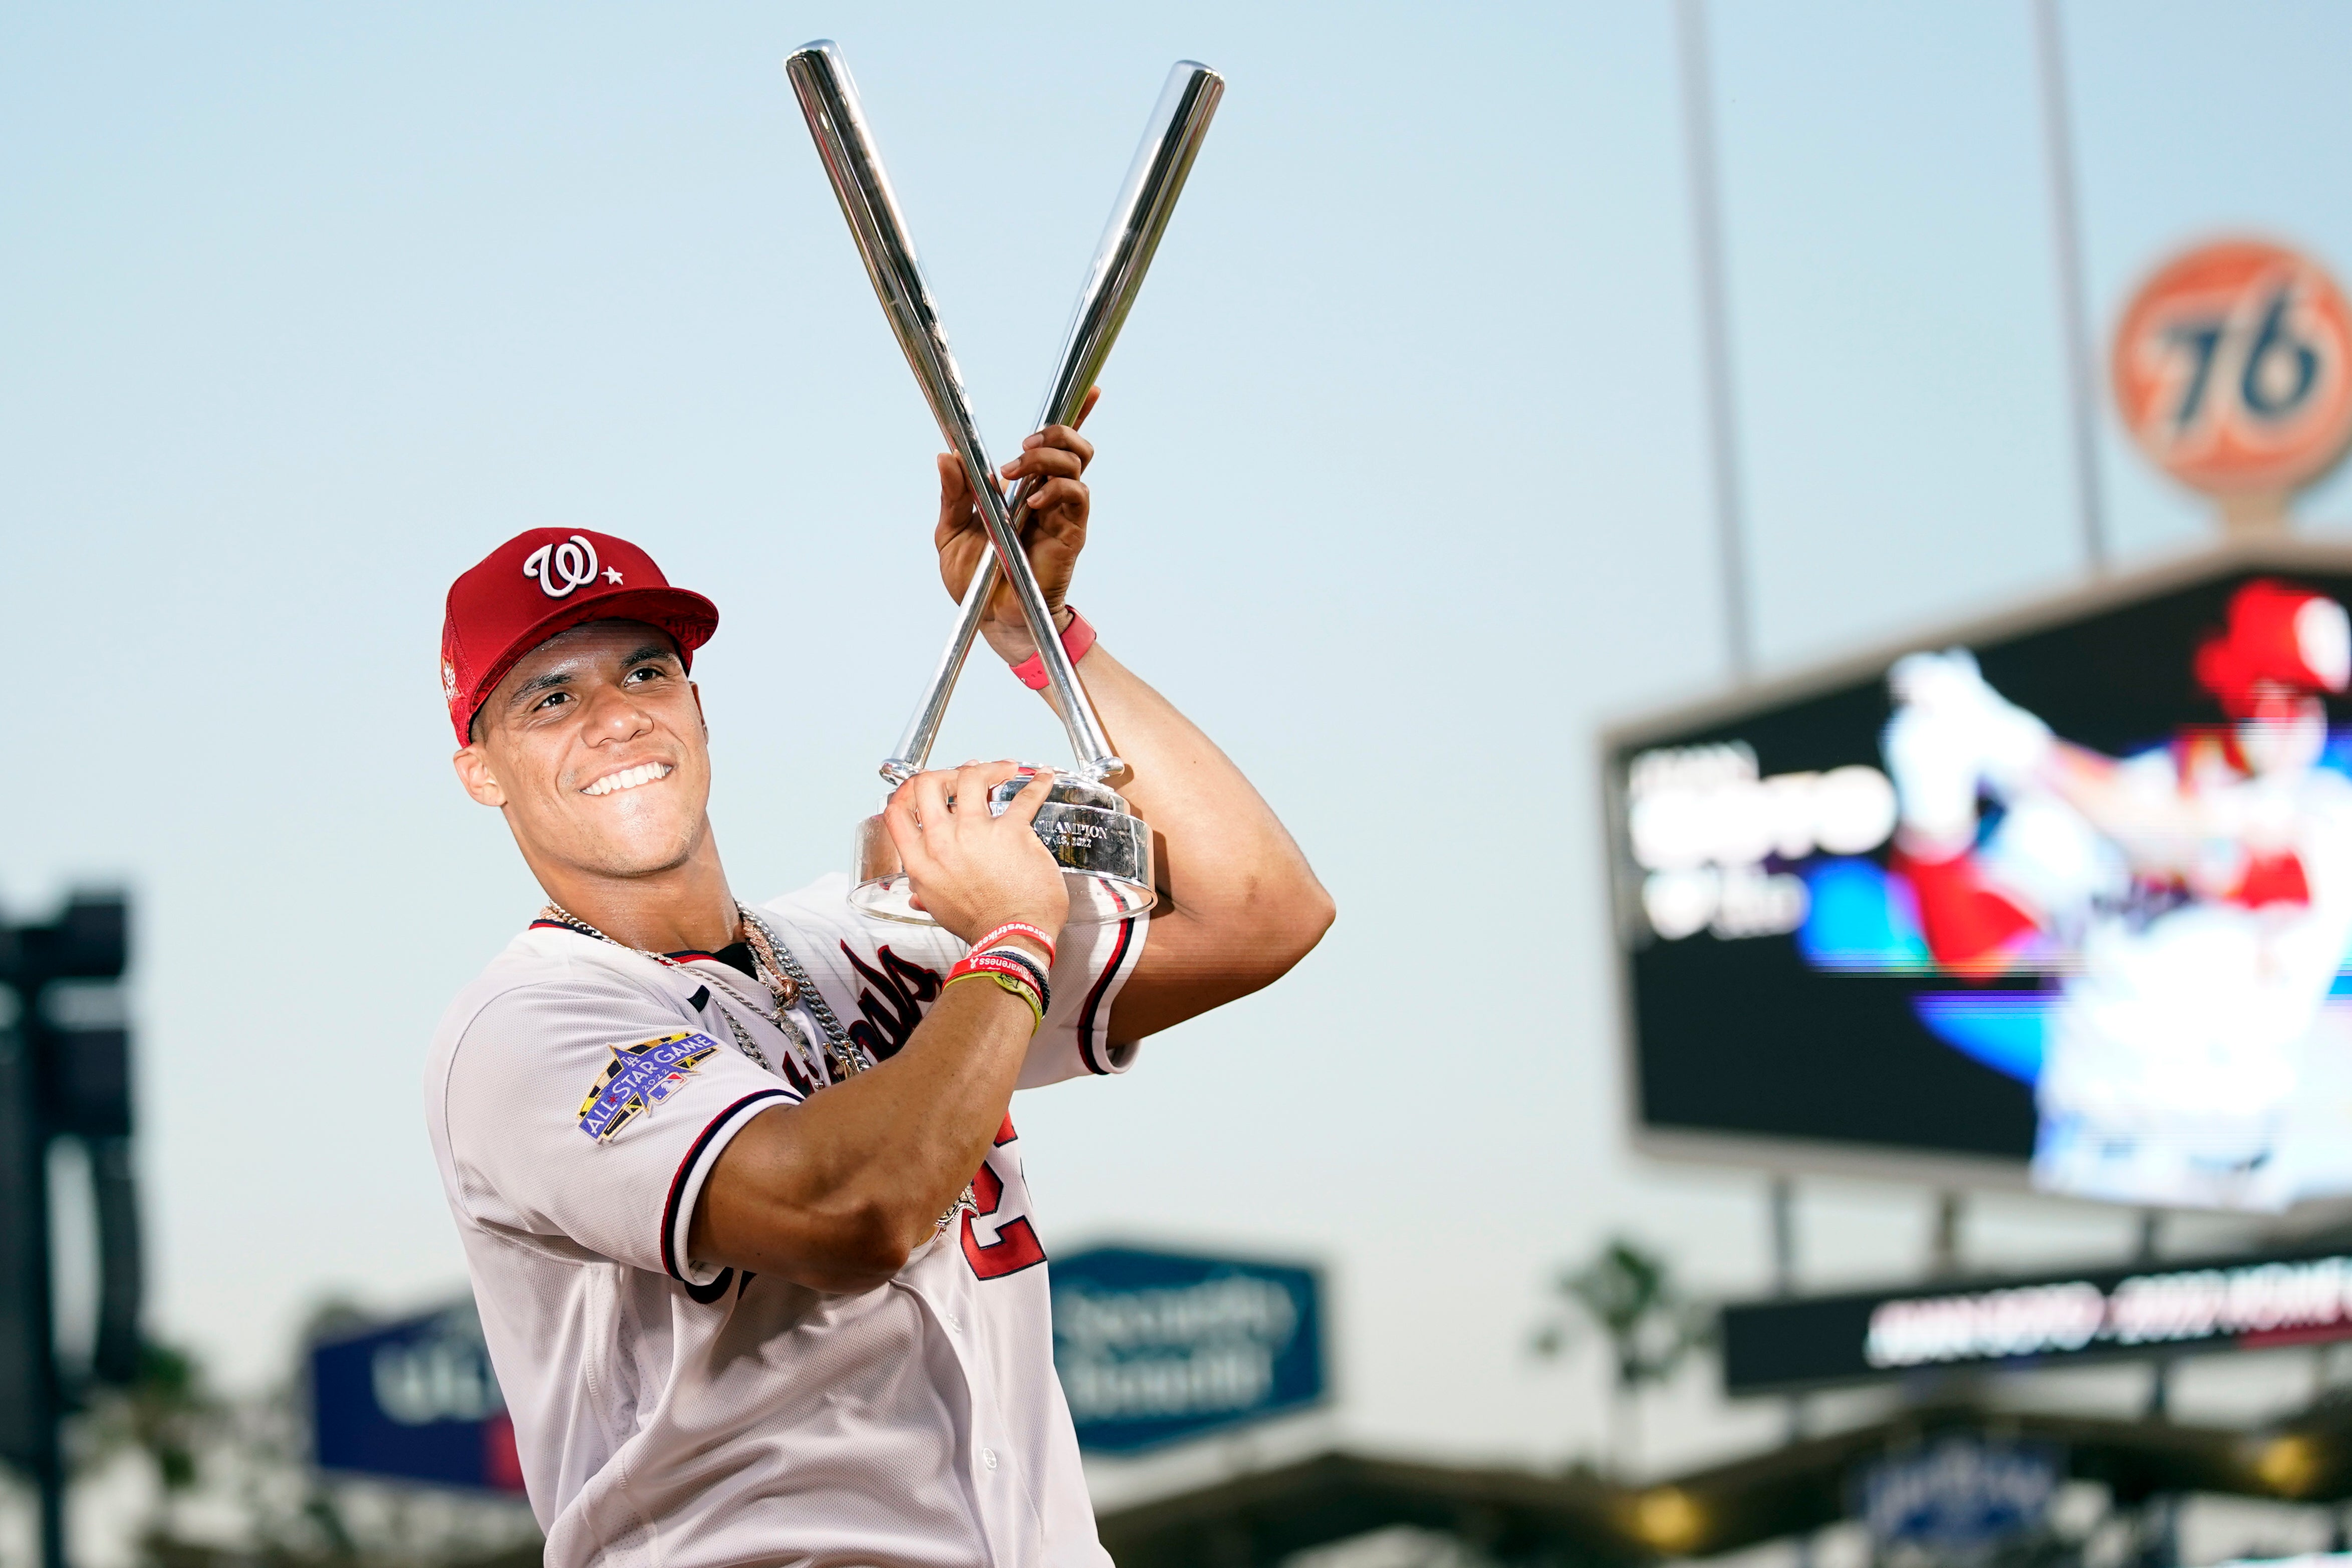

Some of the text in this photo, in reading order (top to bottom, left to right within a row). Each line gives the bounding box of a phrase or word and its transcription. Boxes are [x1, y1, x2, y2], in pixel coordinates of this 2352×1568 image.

[2157, 278, 2323, 437] 76
[522, 535, 599, 600] W
[1033, 820, 1107, 840] CHAMPION
[979, 957, 1030, 981] Awareness
[1024, 986, 1041, 1013] FAITH
[654, 1035, 712, 1064] GAME
[642, 1069, 669, 1092] 2022
